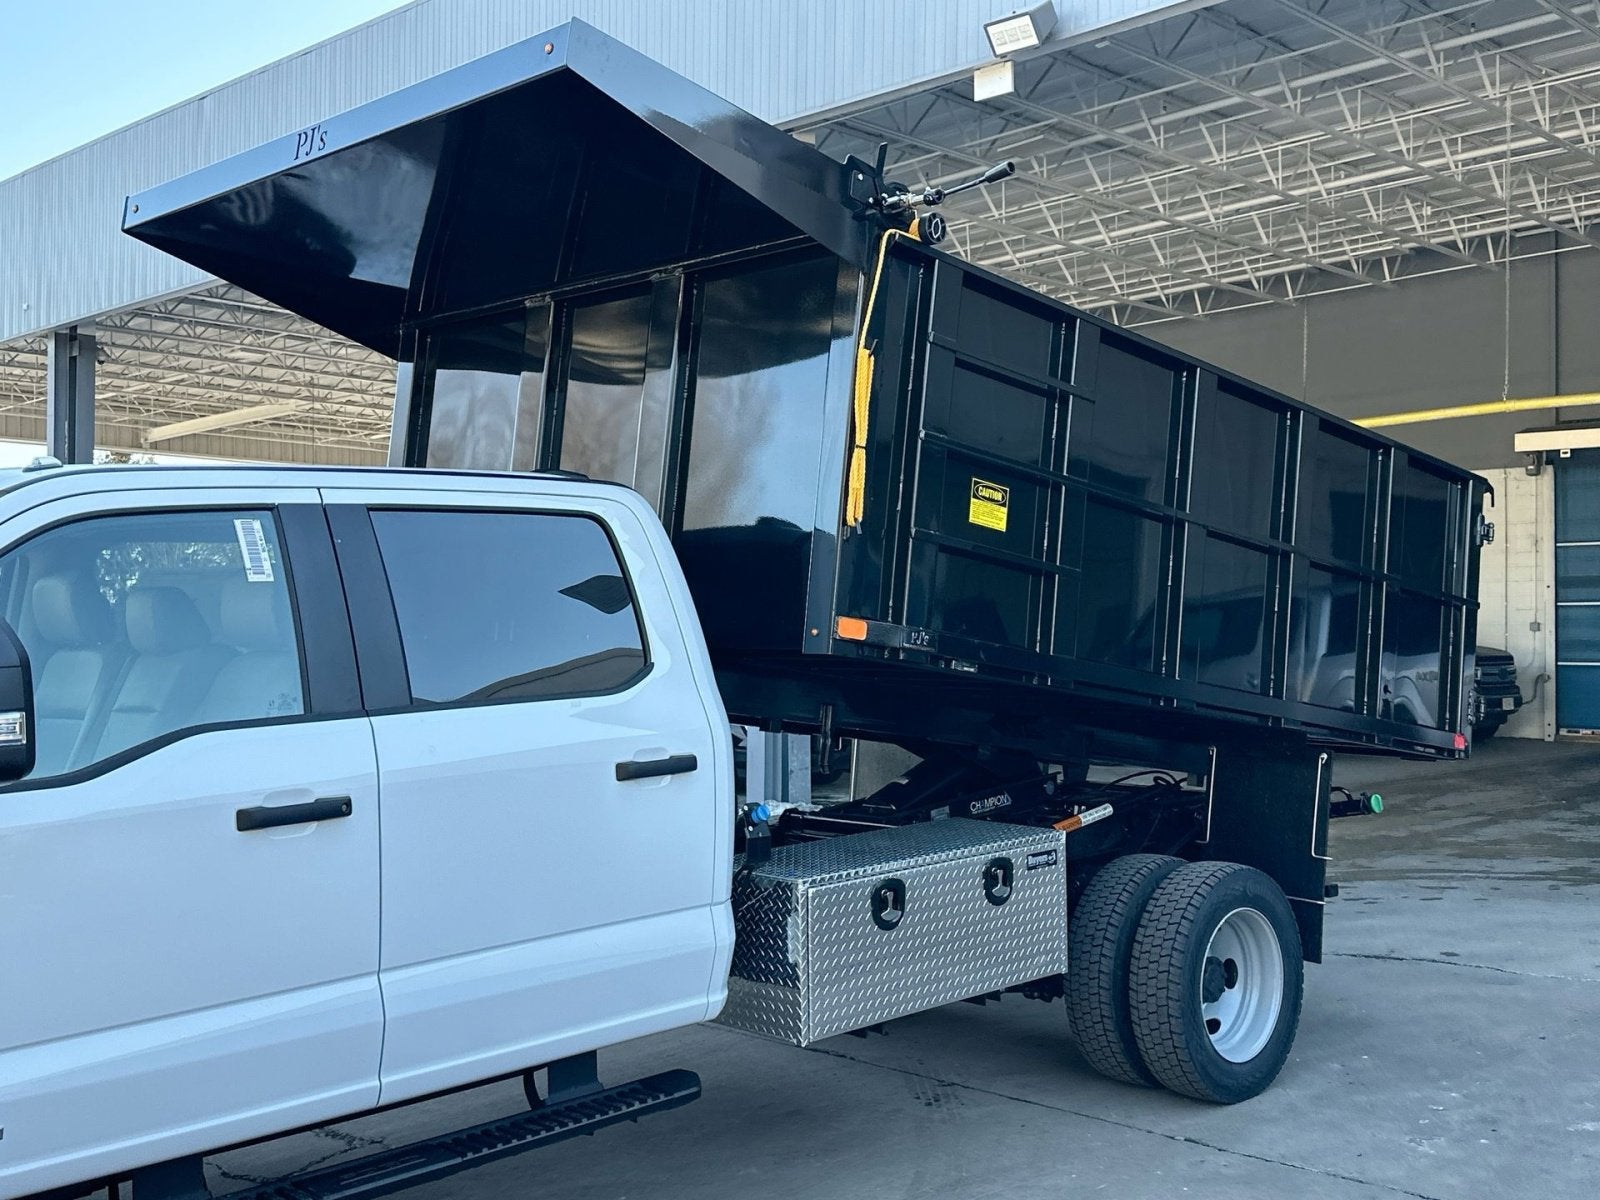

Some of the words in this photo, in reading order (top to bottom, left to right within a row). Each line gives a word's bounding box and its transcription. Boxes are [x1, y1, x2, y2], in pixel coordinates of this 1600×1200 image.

[293, 124, 328, 161] PJ's
[978, 486, 1003, 502] CAUTION
[910, 631, 930, 646] PJ's
